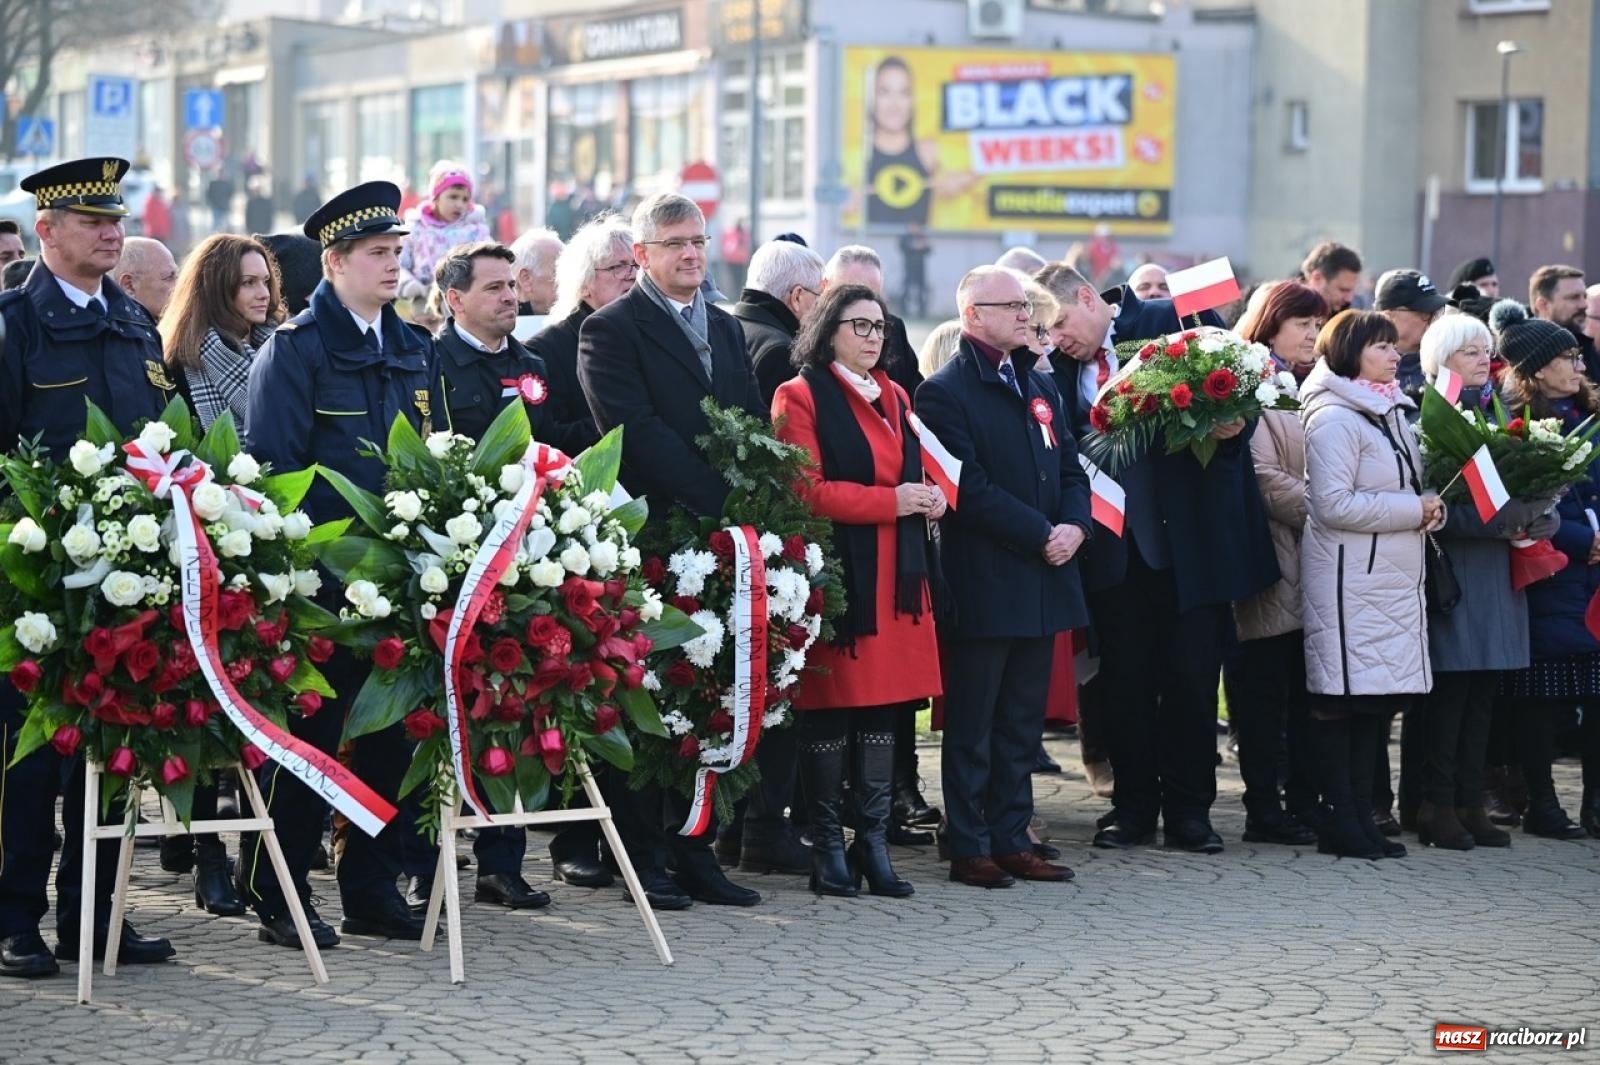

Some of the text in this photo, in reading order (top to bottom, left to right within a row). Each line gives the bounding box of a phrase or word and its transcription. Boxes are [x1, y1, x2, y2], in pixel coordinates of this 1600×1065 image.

[946, 75, 1130, 129] BLACK
[978, 132, 1116, 166] WEEKS!
[185, 545, 215, 658] PREZYDENT
